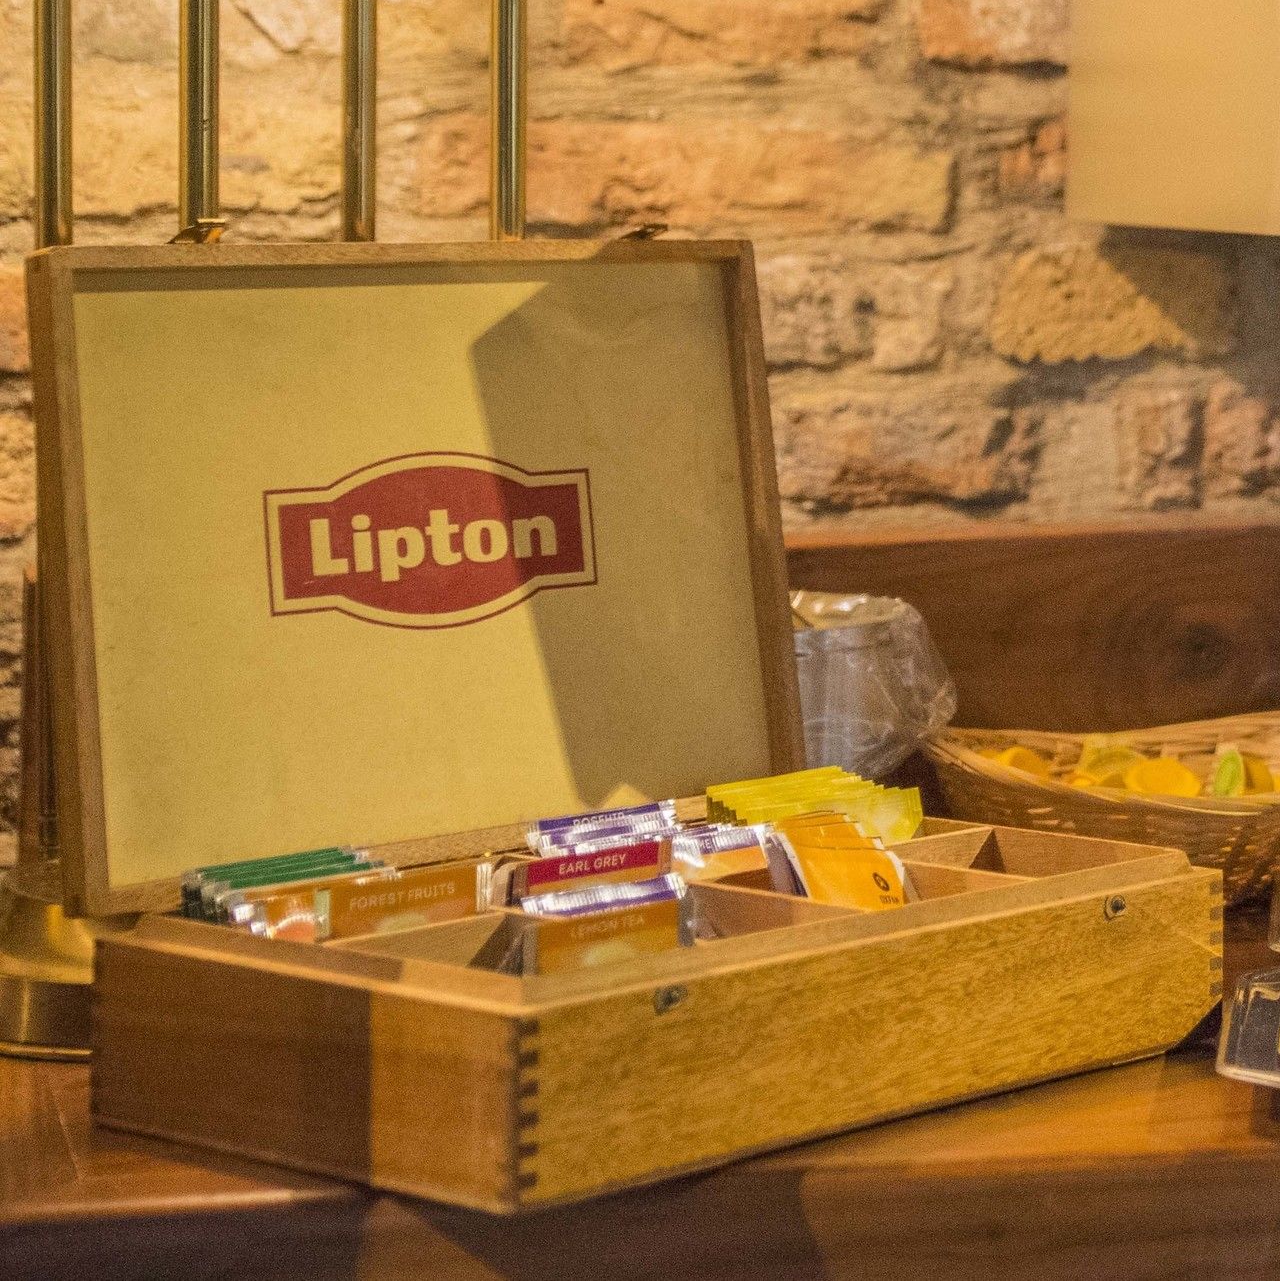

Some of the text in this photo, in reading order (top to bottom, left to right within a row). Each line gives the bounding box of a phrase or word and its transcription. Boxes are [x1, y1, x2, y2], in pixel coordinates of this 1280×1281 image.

[309, 508, 558, 583] Lipton
[558, 853, 627, 876] EARL GREY
[350, 881, 456, 910] FOREST FRUITS
[569, 914, 645, 940] LEMON TEA
